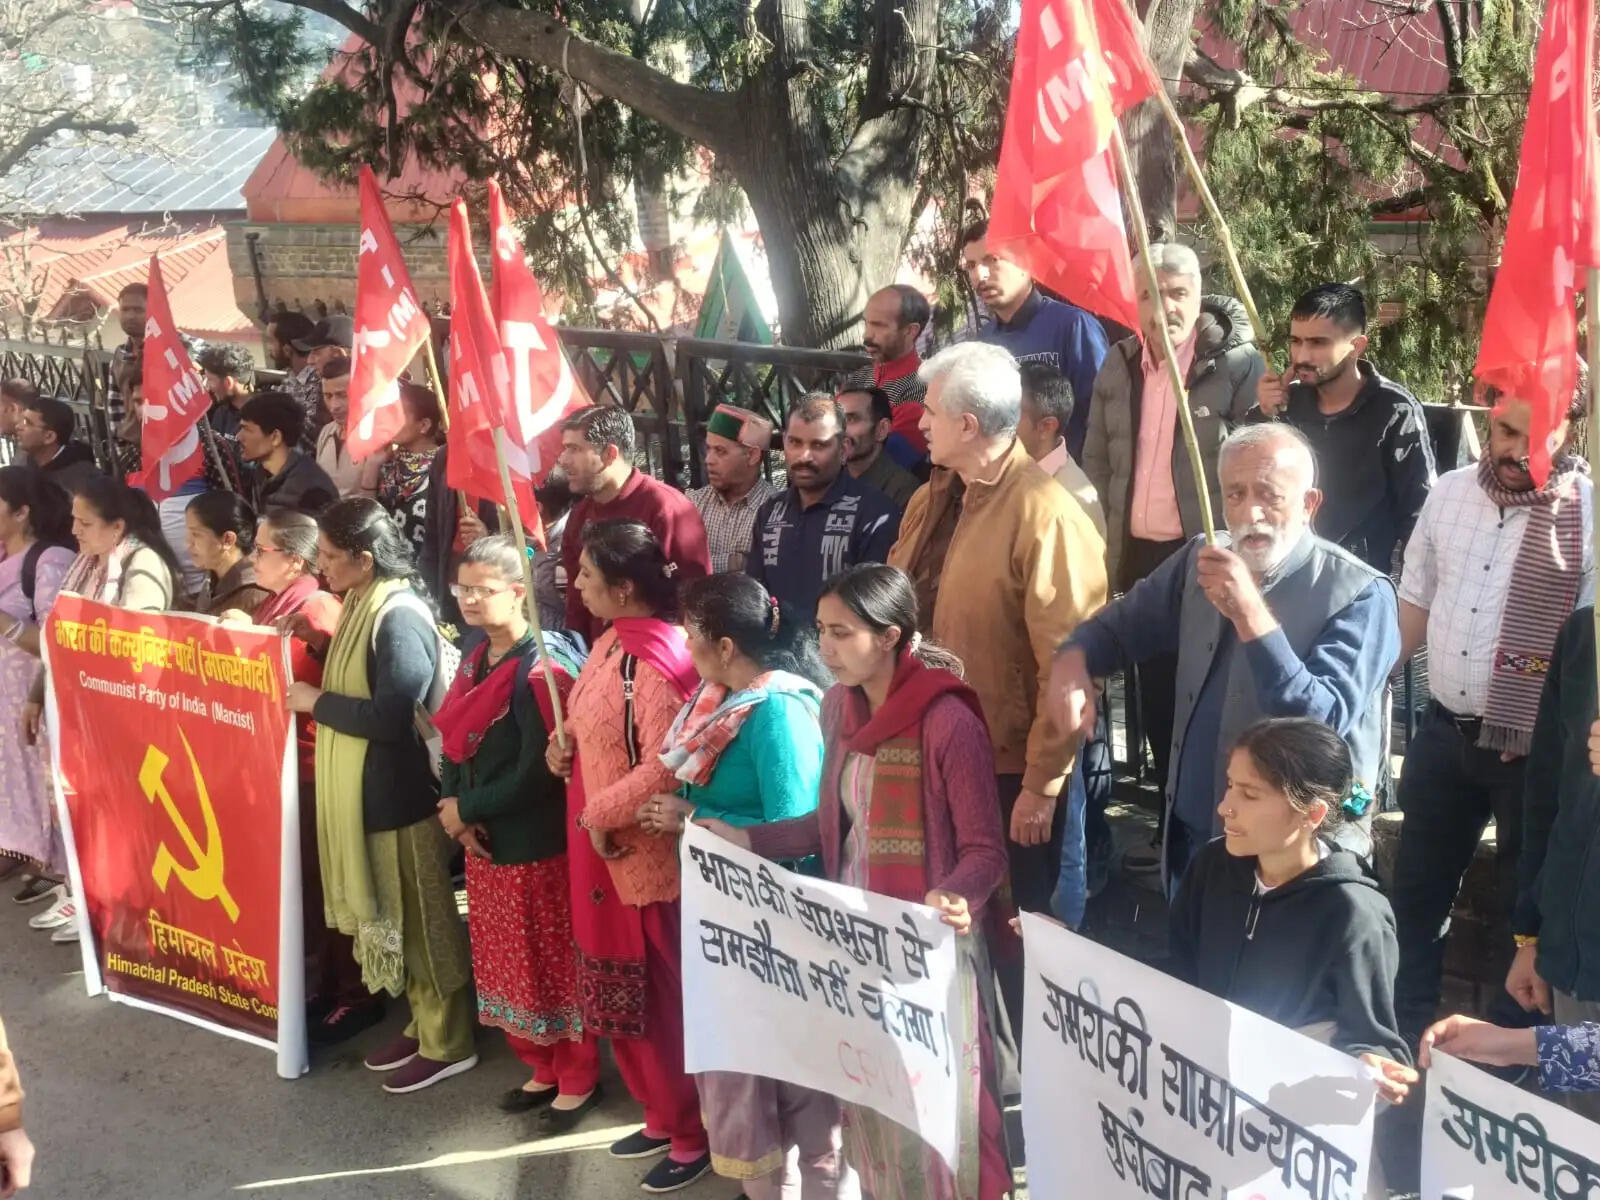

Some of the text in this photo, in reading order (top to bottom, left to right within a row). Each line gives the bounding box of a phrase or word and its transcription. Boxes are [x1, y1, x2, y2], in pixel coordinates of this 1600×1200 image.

[55, 619, 88, 652] भारत
[79, 670, 255, 736] Communist Party of India (Marxist)
[149, 908, 270, 987] हिमाचल प्रदेश
[895, 911, 935, 979] से
[107, 952, 166, 984] Himachal
[168, 969, 217, 1001] Pradesh
[219, 985, 251, 1011] State
